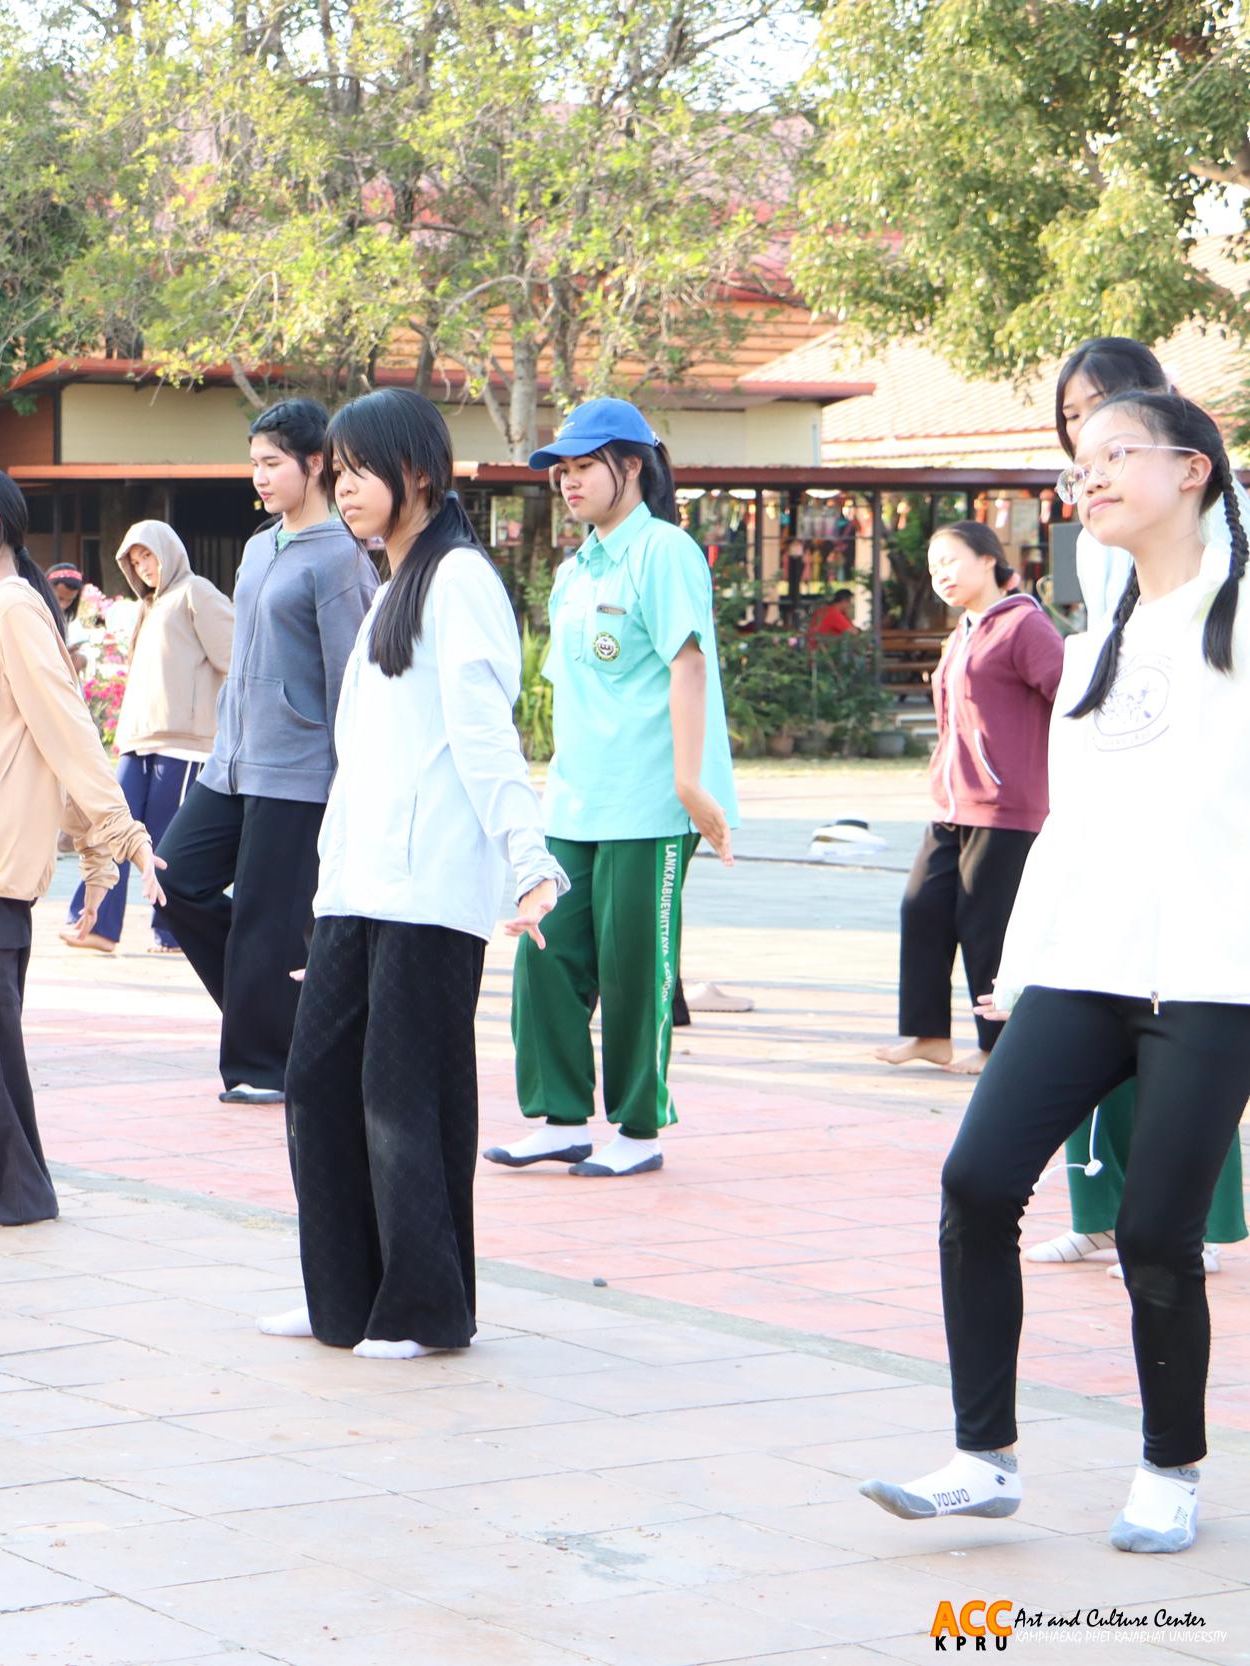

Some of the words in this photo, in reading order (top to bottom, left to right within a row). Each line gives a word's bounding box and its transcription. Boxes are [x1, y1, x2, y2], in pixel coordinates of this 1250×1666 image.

[660, 844, 677, 957] LANKRABUEWITTAYA
[662, 961, 674, 1004] SCHOOL
[932, 1487, 971, 1507] VOLVO
